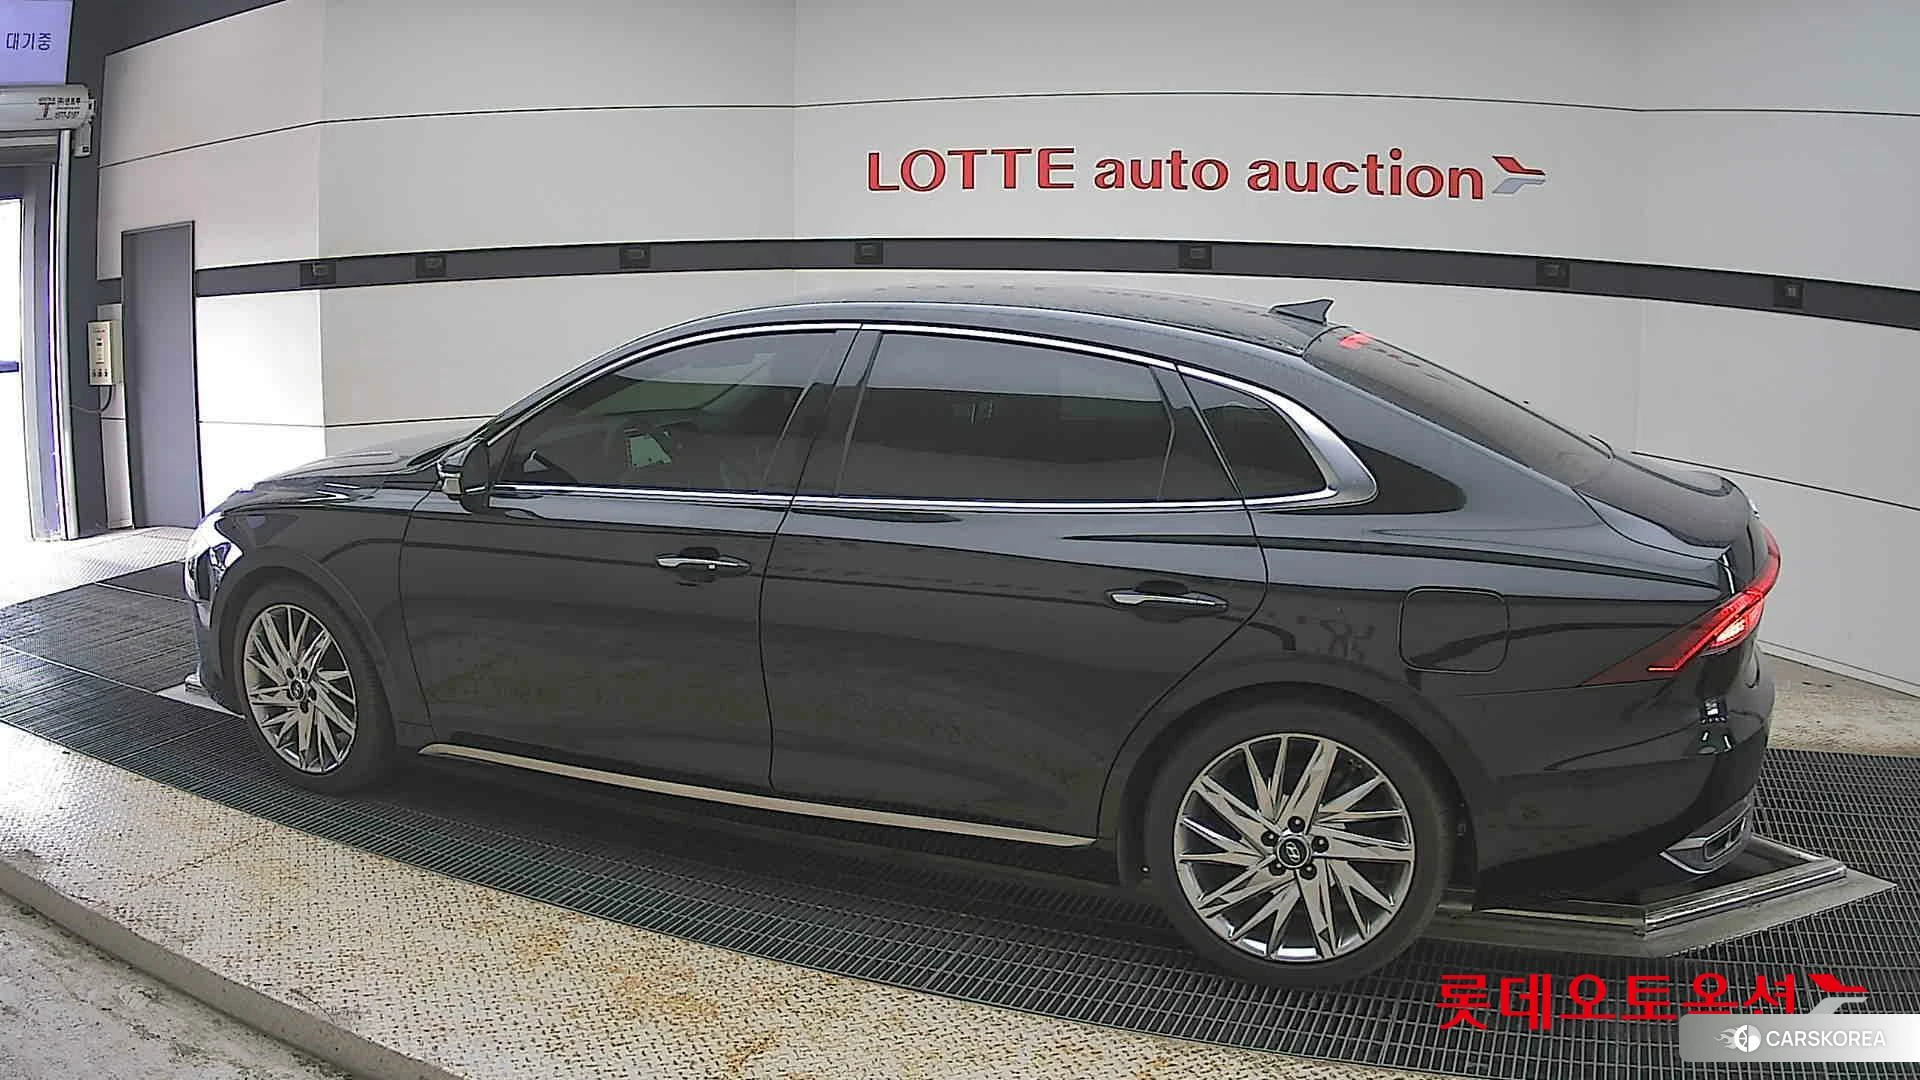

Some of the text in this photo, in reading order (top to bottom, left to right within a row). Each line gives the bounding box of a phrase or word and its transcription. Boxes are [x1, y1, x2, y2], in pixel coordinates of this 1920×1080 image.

[6, 32, 52, 51] 대기중
[867, 147, 1485, 200] LOTTE auto auction
